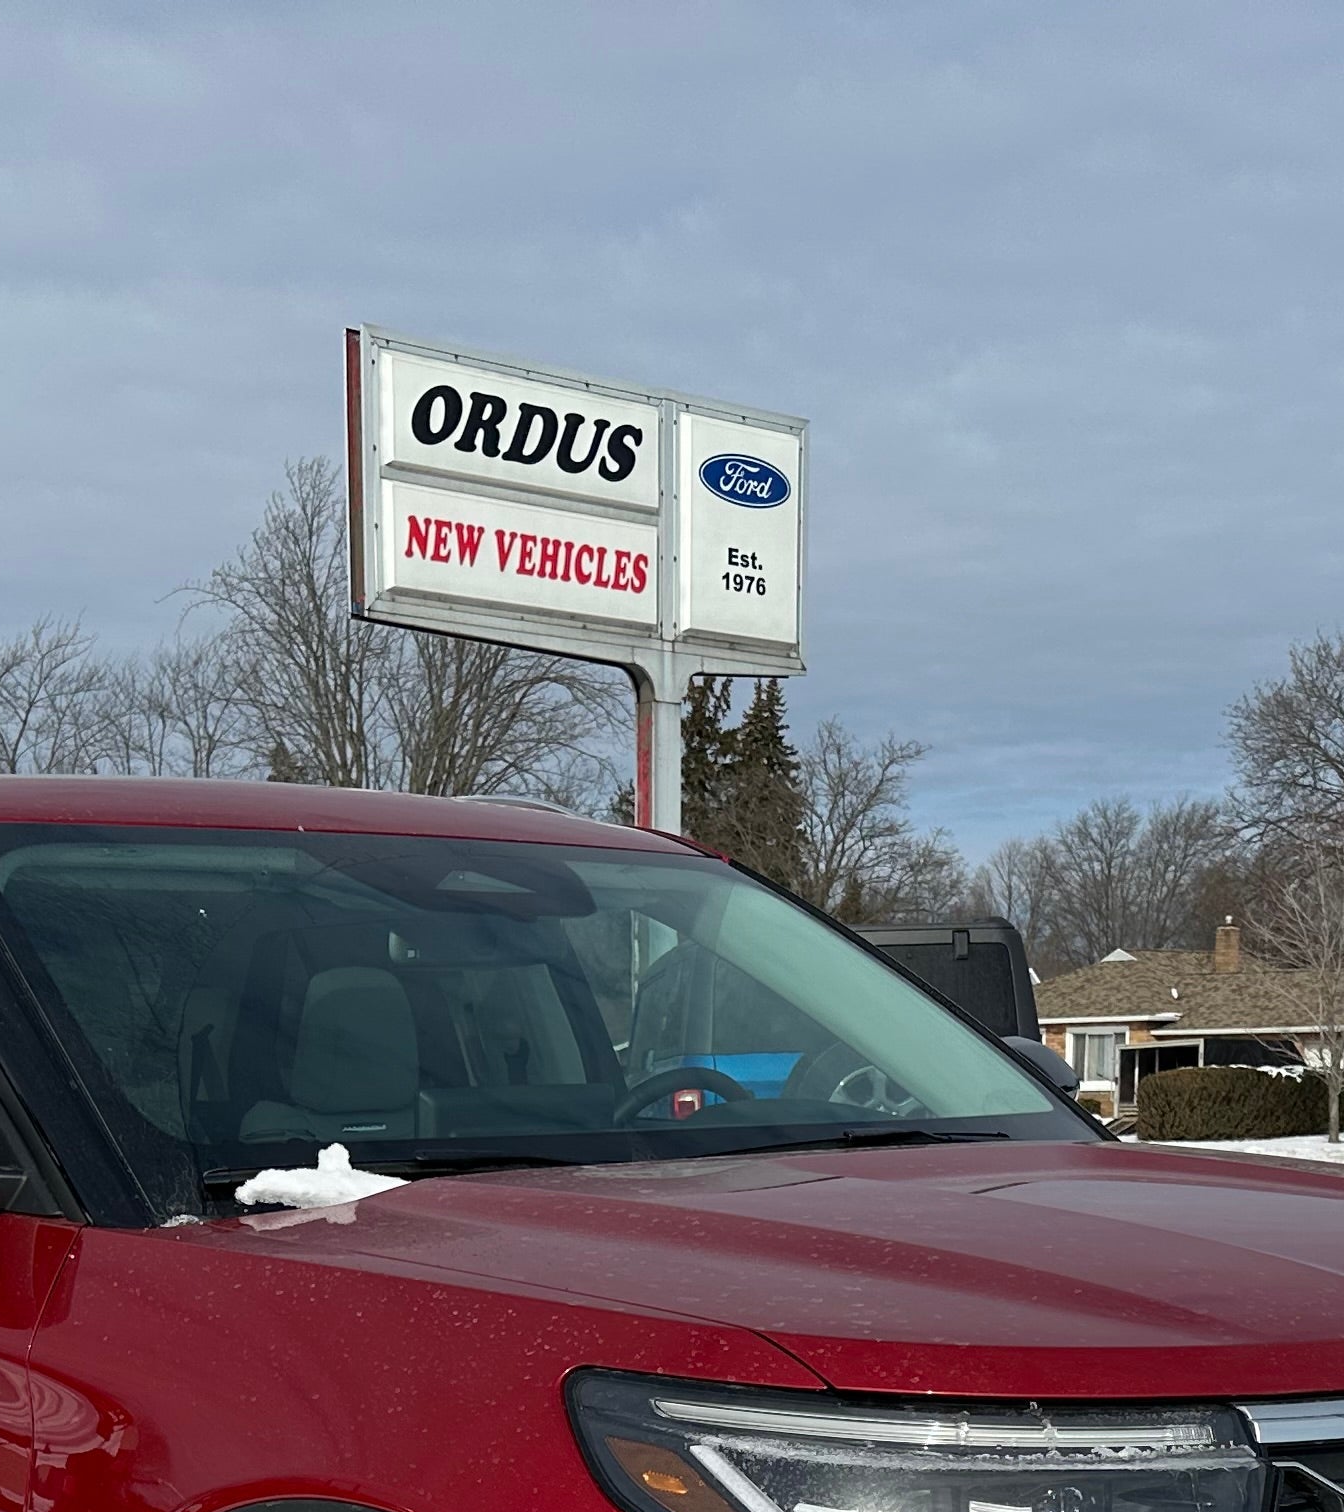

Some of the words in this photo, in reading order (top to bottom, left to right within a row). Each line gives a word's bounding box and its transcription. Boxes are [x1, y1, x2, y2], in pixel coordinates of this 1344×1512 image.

[411, 384, 643, 482] ORDUS
[719, 461, 773, 499] Ford
[405, 515, 485, 568] NEW
[495, 529, 649, 594] VEHICLES
[727, 547, 763, 571] Est.
[722, 572, 766, 596] 1976
